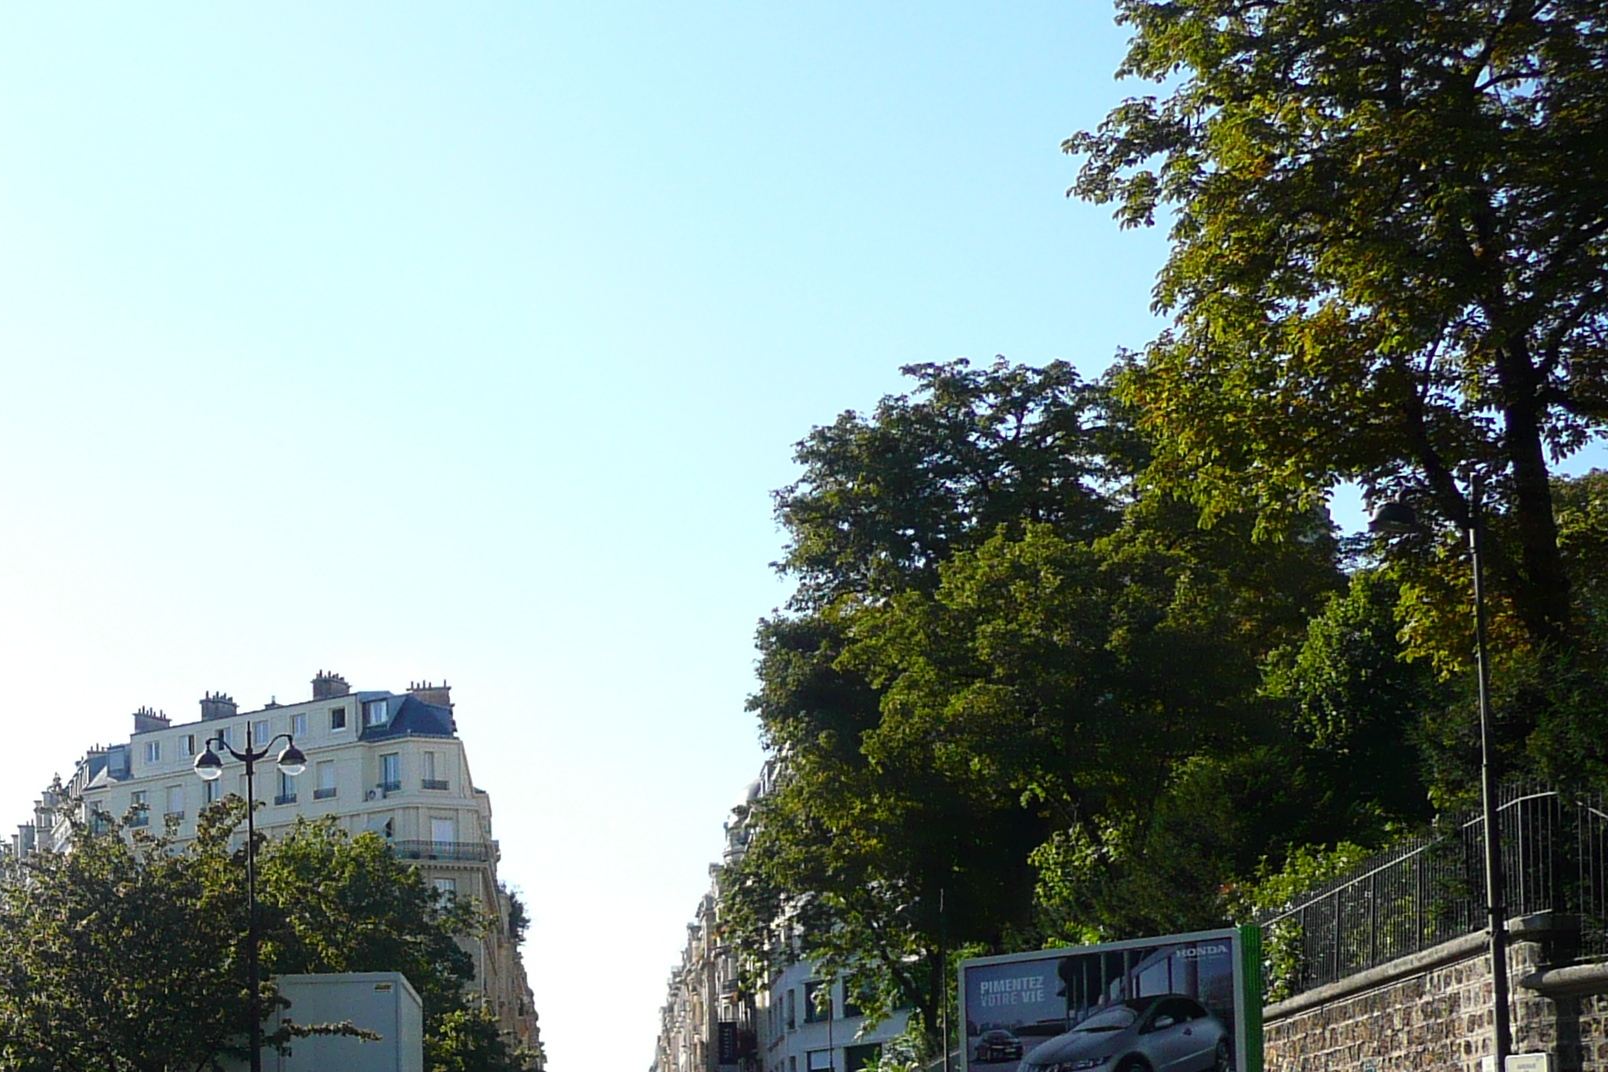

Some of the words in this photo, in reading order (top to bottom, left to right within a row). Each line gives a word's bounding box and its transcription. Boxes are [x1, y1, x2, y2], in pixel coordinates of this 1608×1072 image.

[1176, 945, 1229, 958] HONDA
[980, 975, 1045, 994] PIMENTEZ
[980, 991, 1018, 1007] VOTRE
[1021, 988, 1045, 1003] VIE
